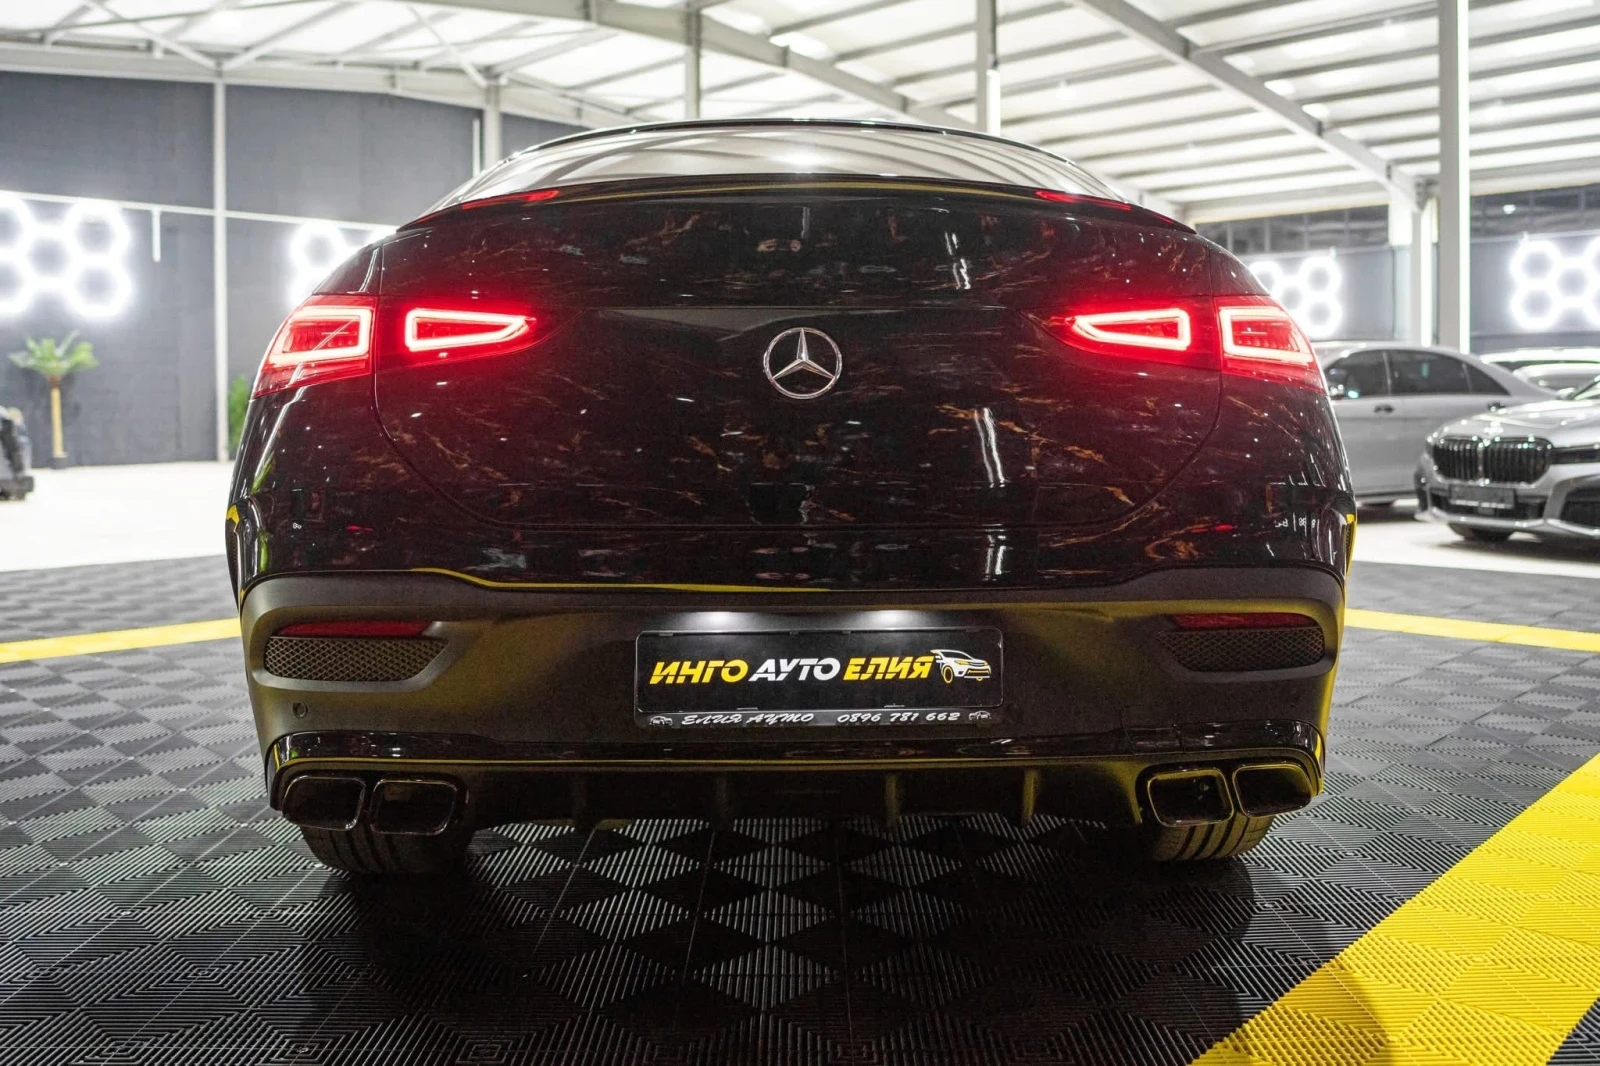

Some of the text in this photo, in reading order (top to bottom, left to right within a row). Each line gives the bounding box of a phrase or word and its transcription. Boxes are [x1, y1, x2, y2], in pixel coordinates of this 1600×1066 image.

[649, 655, 935, 685] ИНГО АУТО ЕЛИЯ
[837, 712, 882, 723] 0896
[890, 712, 919, 722] 781
[926, 712, 961, 721] 662
